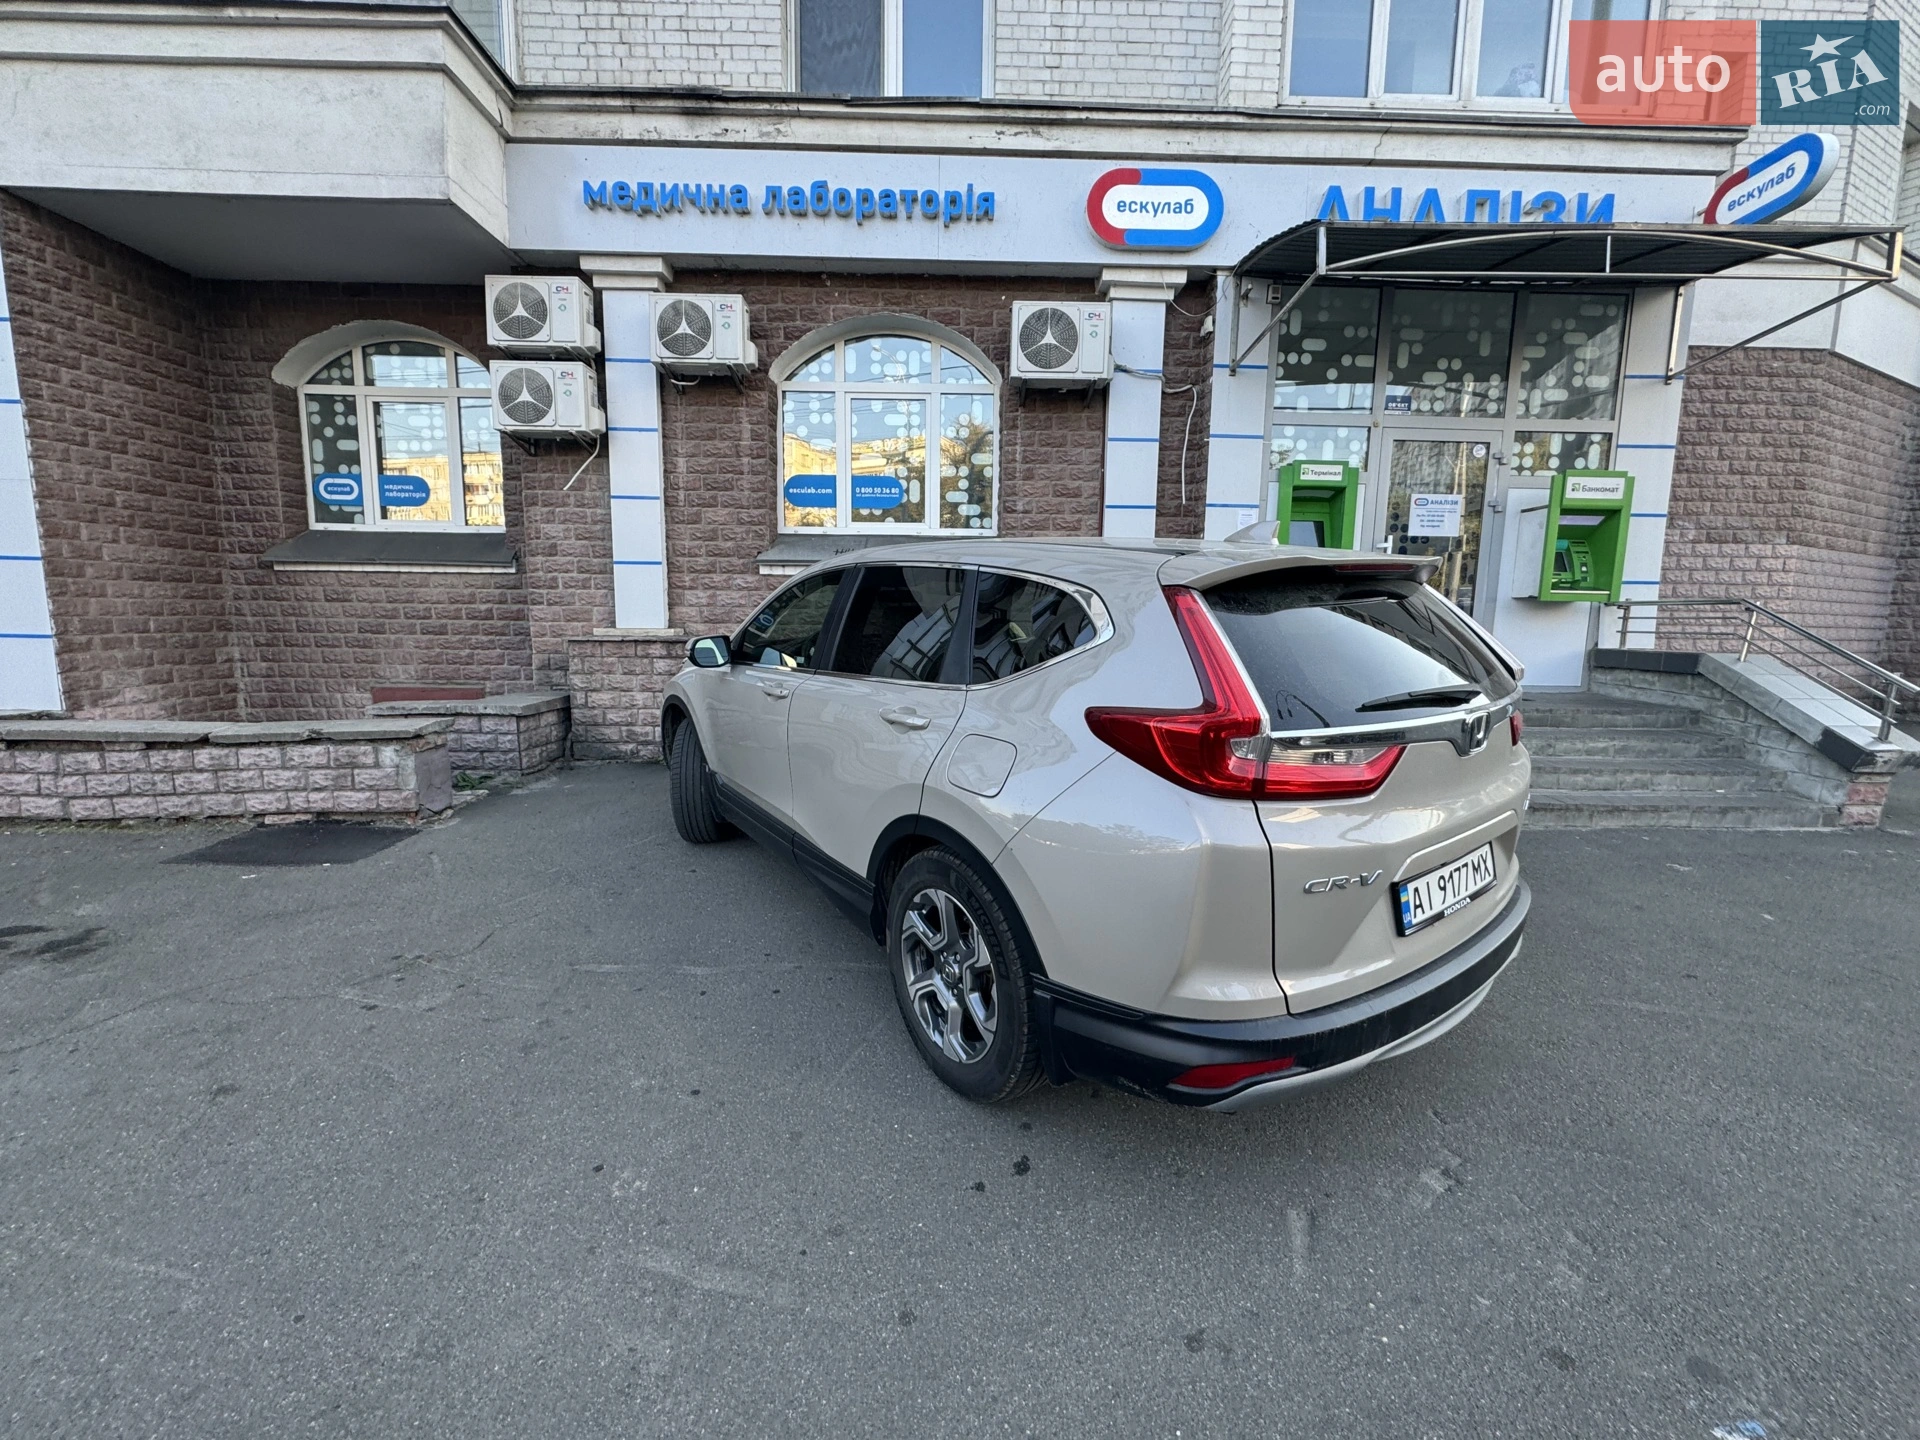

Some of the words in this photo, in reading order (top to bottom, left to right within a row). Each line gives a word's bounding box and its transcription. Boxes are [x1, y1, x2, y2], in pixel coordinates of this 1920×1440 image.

[1727, 162, 1796, 212] ескулаб
[582, 179, 750, 217] медична
[761, 179, 996, 227] лабораторія
[1116, 197, 1194, 216] ескулаб
[1310, 469, 1341, 477] Термінал
[788, 486, 833, 494] esculab.com
[1581, 484, 1619, 493] Банкомат
[1303, 869, 1384, 895] CR-V
[1413, 881, 1434, 919] AI
[1437, 861, 1469, 905] 9177
[1472, 850, 1492, 888] MX
[1444, 897, 1471, 917] HONDA
[1403, 913, 1411, 924] UA
